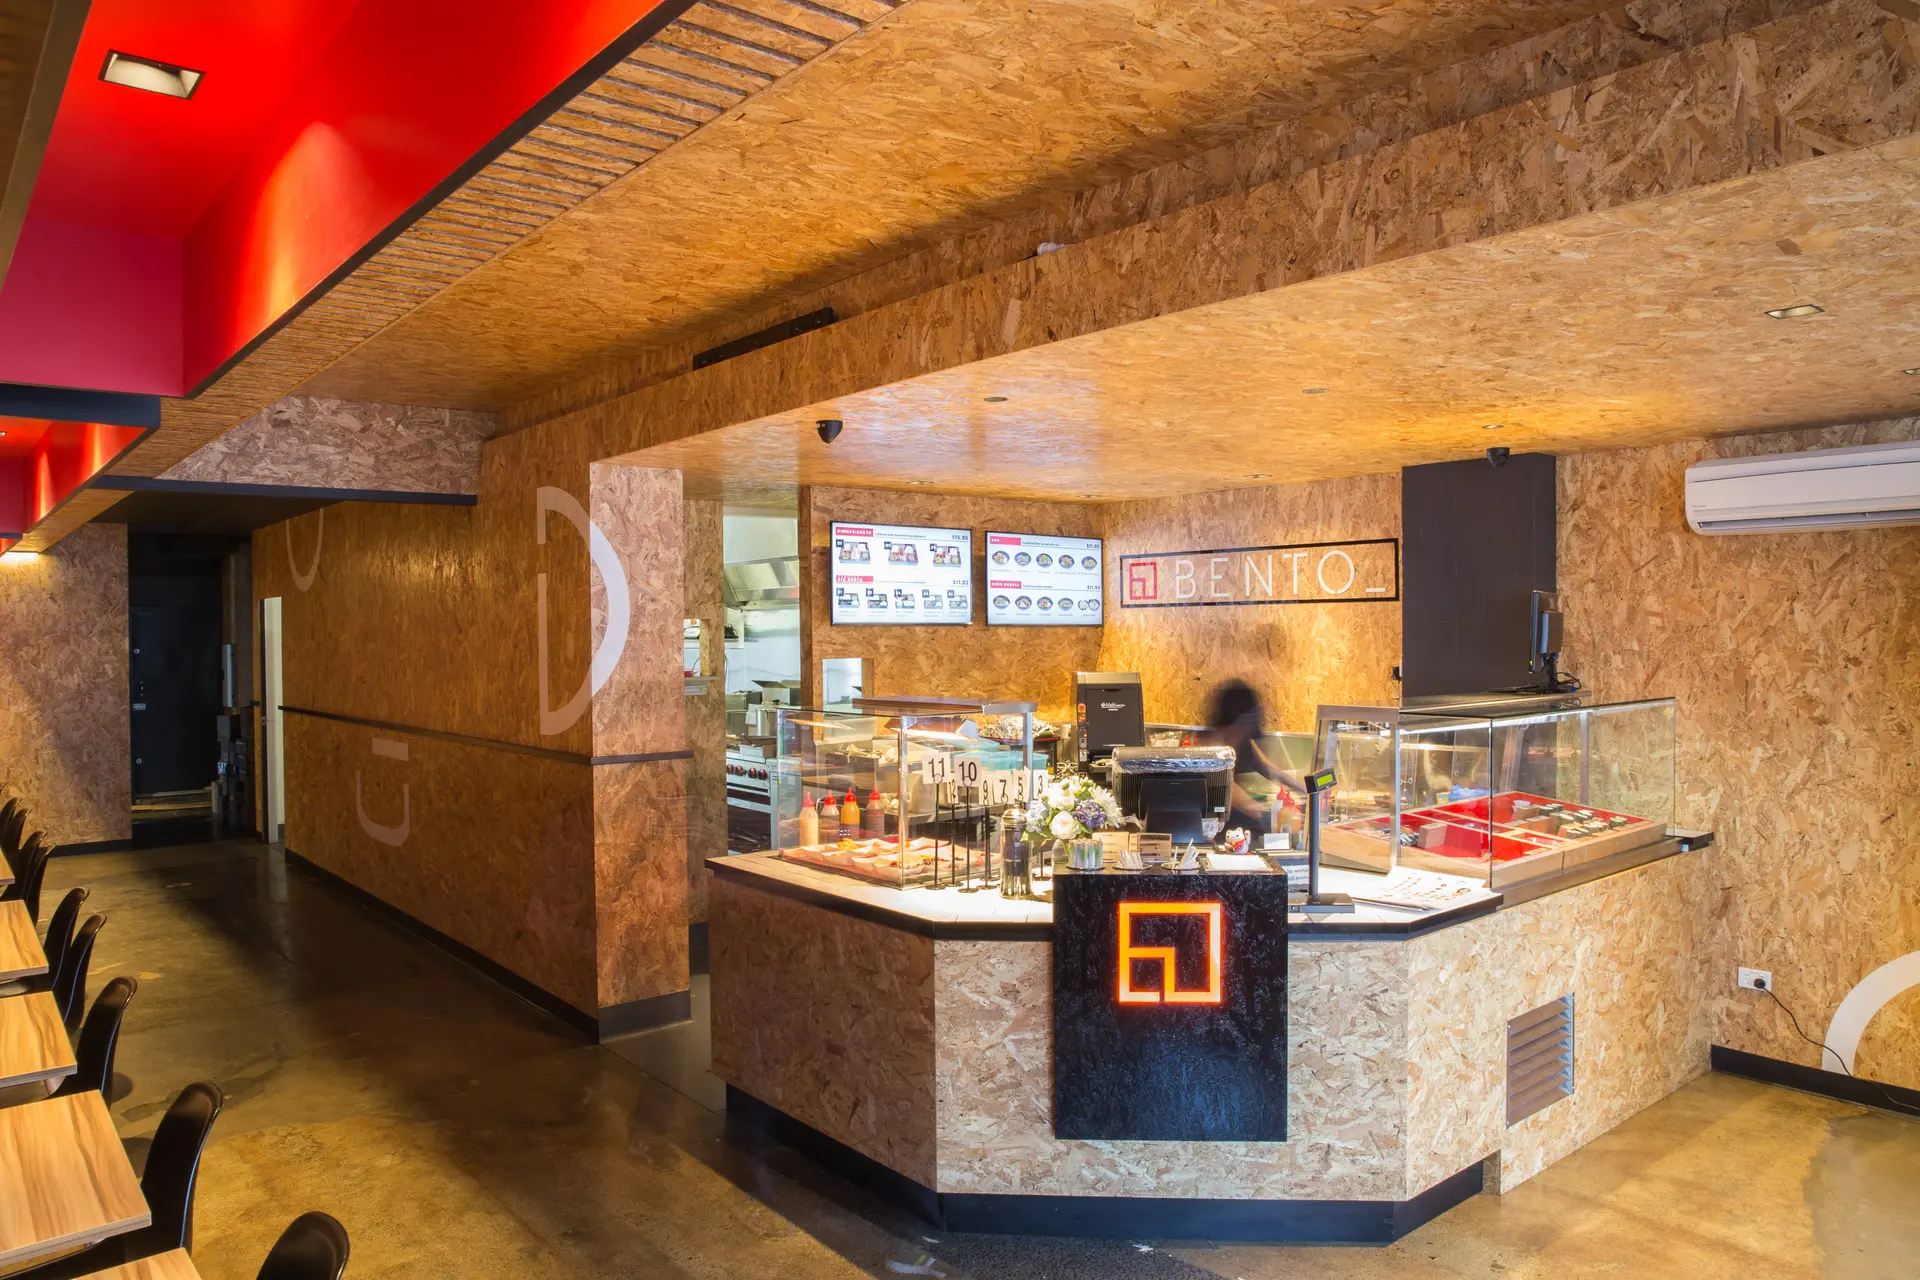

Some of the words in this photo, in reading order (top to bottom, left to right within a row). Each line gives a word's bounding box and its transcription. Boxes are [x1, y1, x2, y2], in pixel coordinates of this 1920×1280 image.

[928, 757, 945, 778] 11
[958, 761, 978, 782] 10
[982, 780, 989, 800] 9
[999, 779, 1007, 798] 7
[1017, 776, 1024, 797] 5
[1037, 775, 1043, 794] 3
